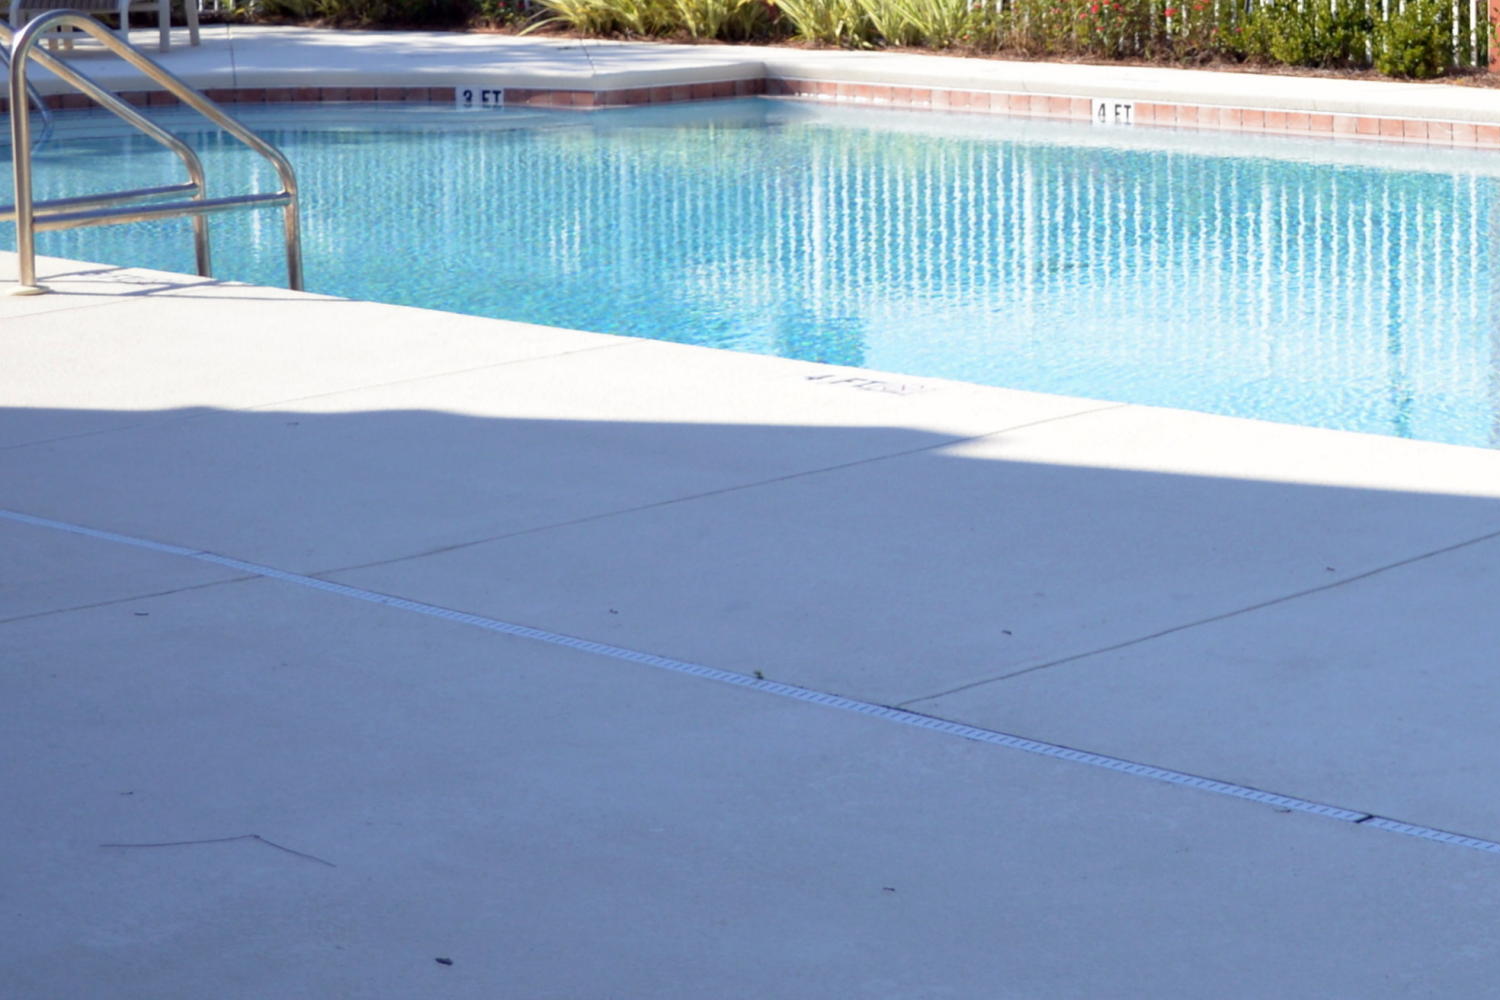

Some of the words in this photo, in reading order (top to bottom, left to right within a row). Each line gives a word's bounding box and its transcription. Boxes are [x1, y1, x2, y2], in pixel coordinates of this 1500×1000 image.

[463, 89, 473, 105] 3
[482, 89, 502, 105] FT
[1097, 102, 1106, 119] 4
[1114, 103, 1132, 120] FT
